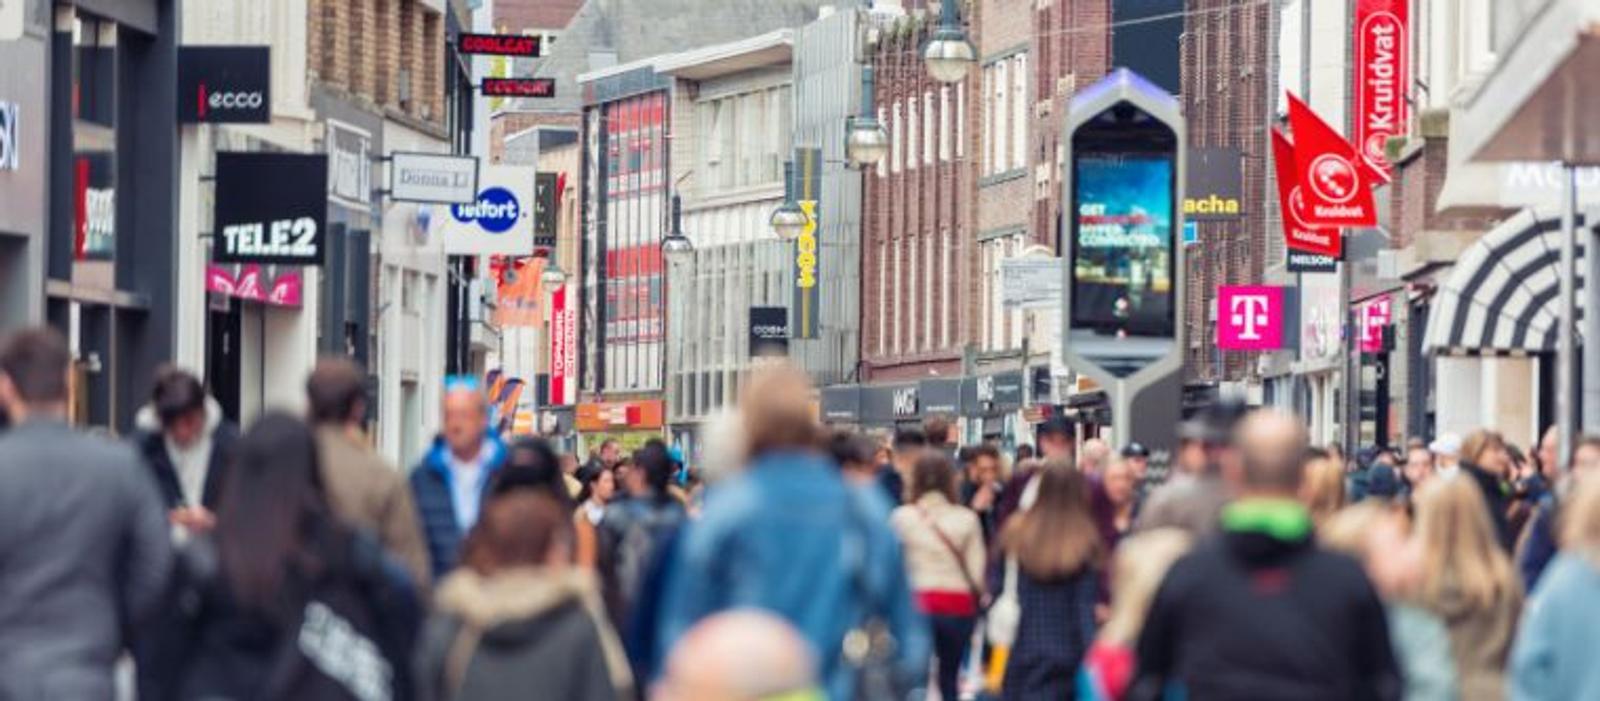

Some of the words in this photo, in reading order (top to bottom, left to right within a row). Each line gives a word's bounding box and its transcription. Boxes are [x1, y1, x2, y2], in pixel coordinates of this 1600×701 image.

[1369, 23, 1394, 130] Kruidvat
[208, 91, 262, 109] ecco
[400, 168, 448, 187] Donna
[1314, 204, 1364, 218] Kruidvat
[223, 217, 316, 256] TELE2
[1290, 254, 1334, 265] NELSON
[1230, 295, 1269, 340] T
